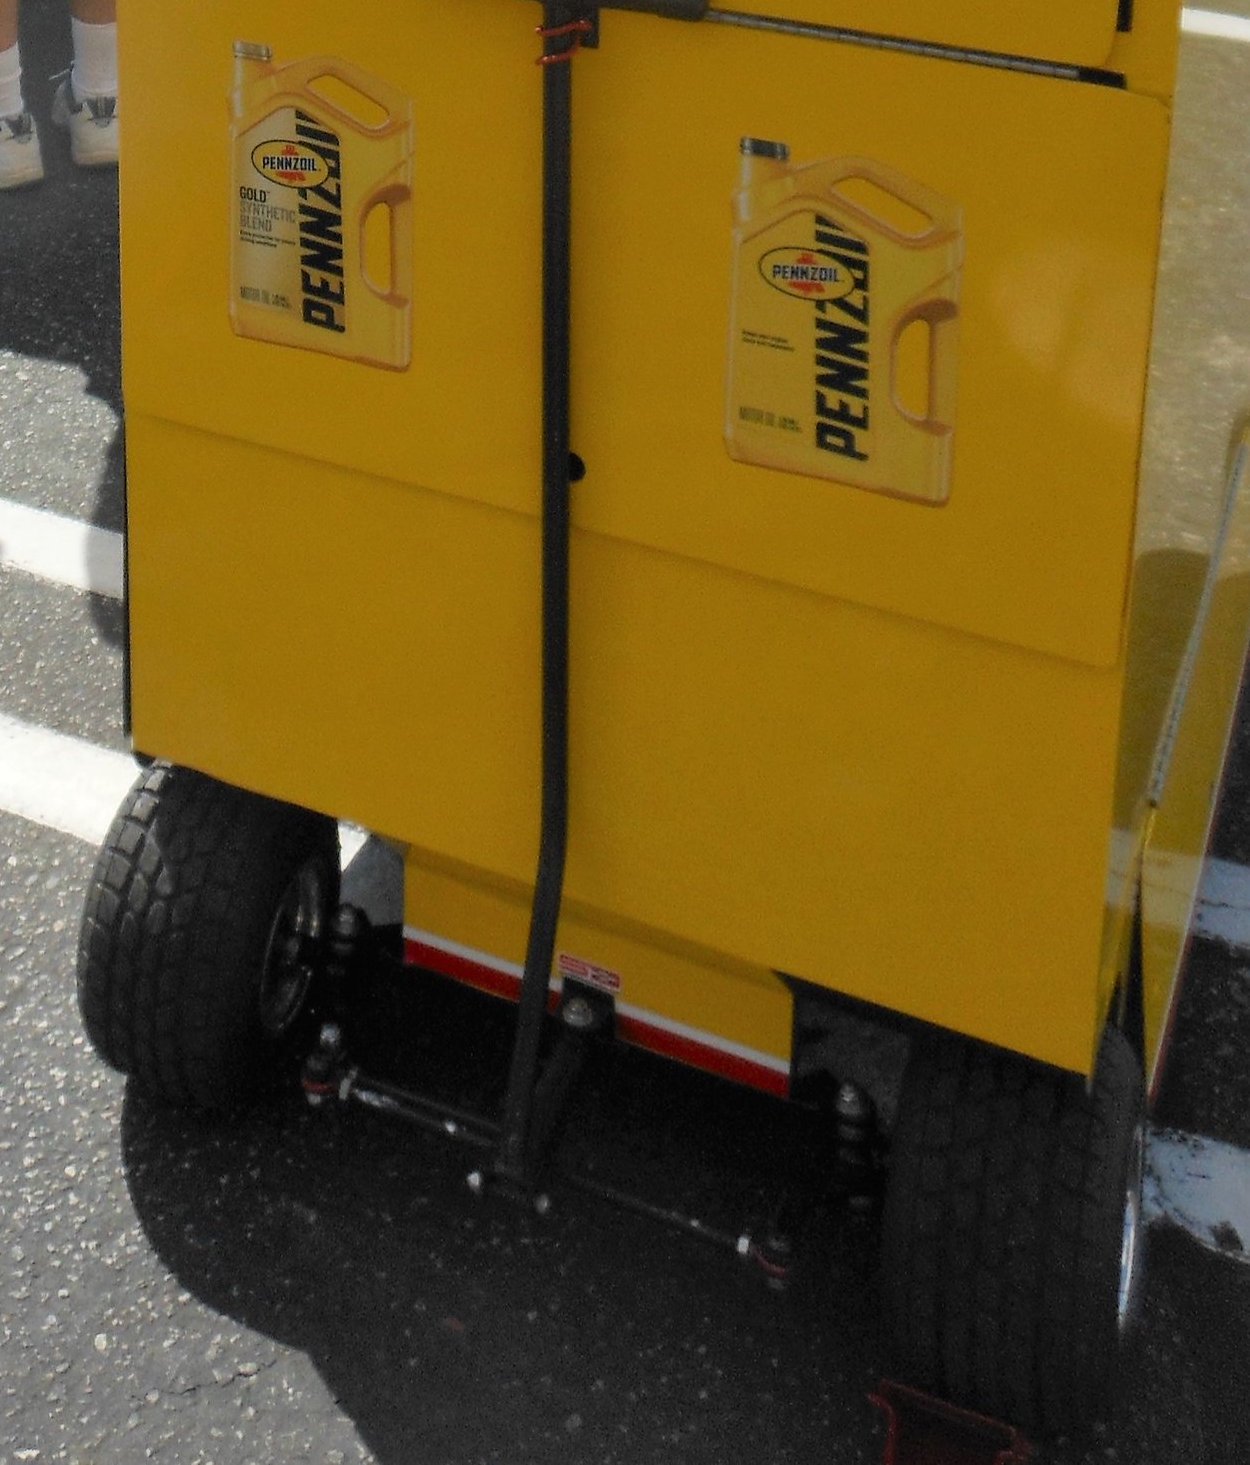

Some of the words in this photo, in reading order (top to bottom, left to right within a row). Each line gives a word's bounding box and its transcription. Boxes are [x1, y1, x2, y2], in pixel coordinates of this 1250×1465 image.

[262, 155, 317, 172] PENNZOIL
[239, 186, 267, 203] GOLD
[239, 199, 296, 224] SYNTHETIC
[239, 213, 272, 233] BLEND
[772, 264, 840, 282] PENNZOIL
